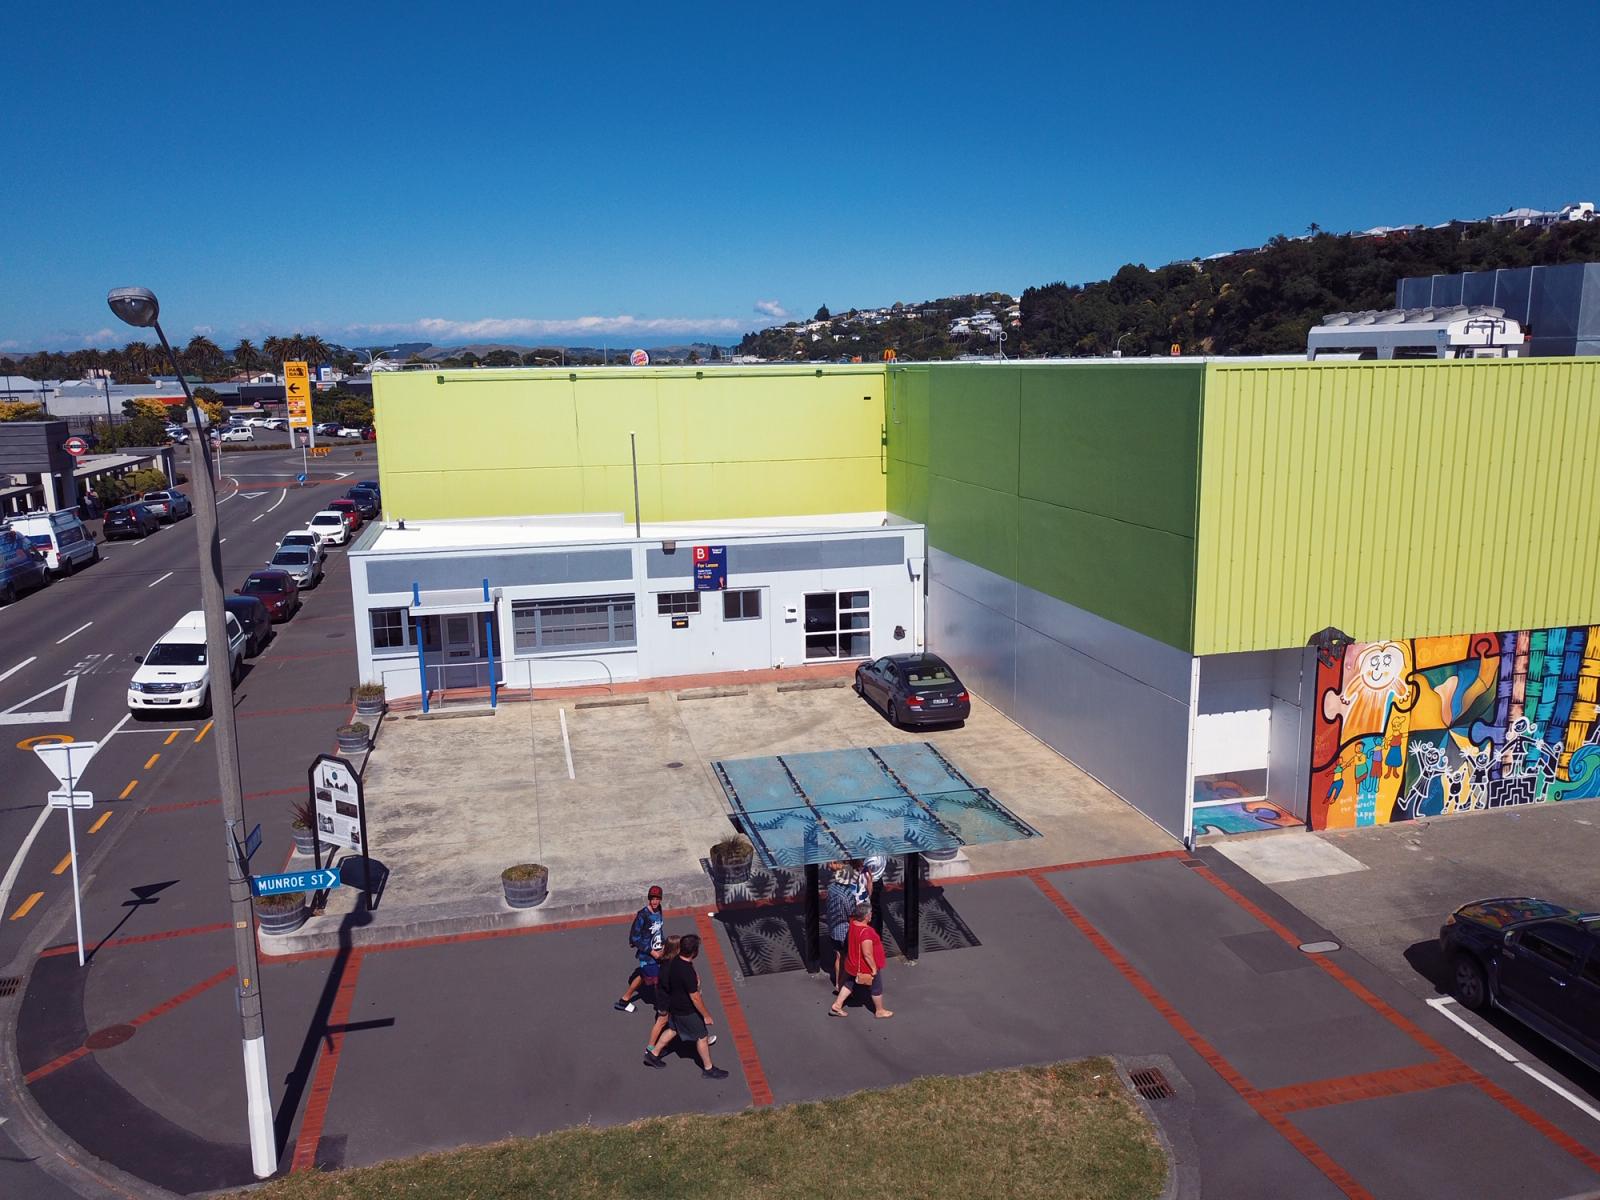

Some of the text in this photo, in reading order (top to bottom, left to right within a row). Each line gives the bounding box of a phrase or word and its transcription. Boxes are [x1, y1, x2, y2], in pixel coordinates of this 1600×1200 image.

[697, 548, 705, 559] B
[258, 874, 324, 891] MUNROE ST
